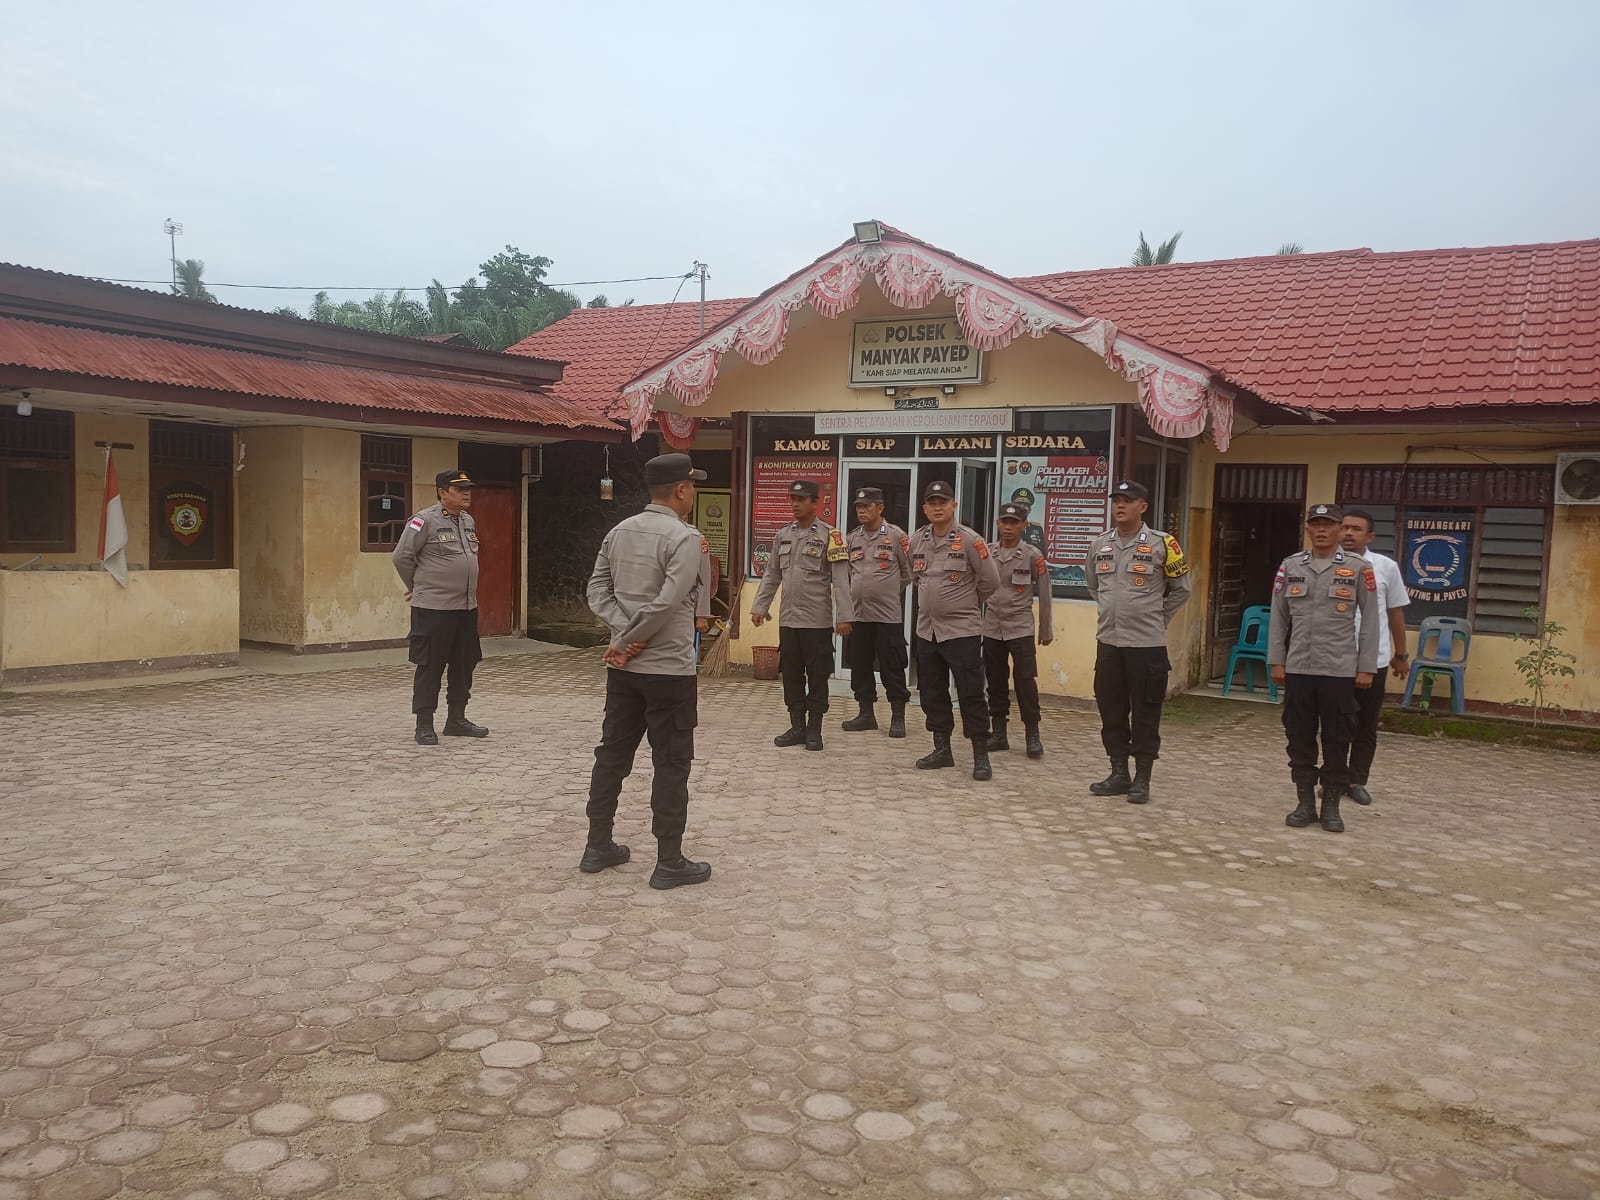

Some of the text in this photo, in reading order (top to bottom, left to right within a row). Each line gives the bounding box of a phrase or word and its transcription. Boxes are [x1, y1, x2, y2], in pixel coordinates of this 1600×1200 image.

[885, 323, 946, 343] POLSEK
[860, 344, 970, 366] MANYAK PAYED
[866, 369, 884, 377] KAMI
[886, 368, 902, 377] SIAP
[903, 367, 939, 376] MELAYANI
[940, 366, 962, 374] ANDA
[820, 412, 1006, 430] SENTRA PELAYANAN KEPOLISIAN TERPADU
[774, 435, 1086, 452] KAMOE SIAP LAYANI SEDARA
[764, 461, 801, 470] KOMITMEN
[802, 461, 833, 470] KAPOLRI
[1037, 466, 1090, 475] POLDA ACEH
[1033, 475, 1108, 488] MEUTUAH
[1407, 519, 1471, 531] BHAYANGKARI
